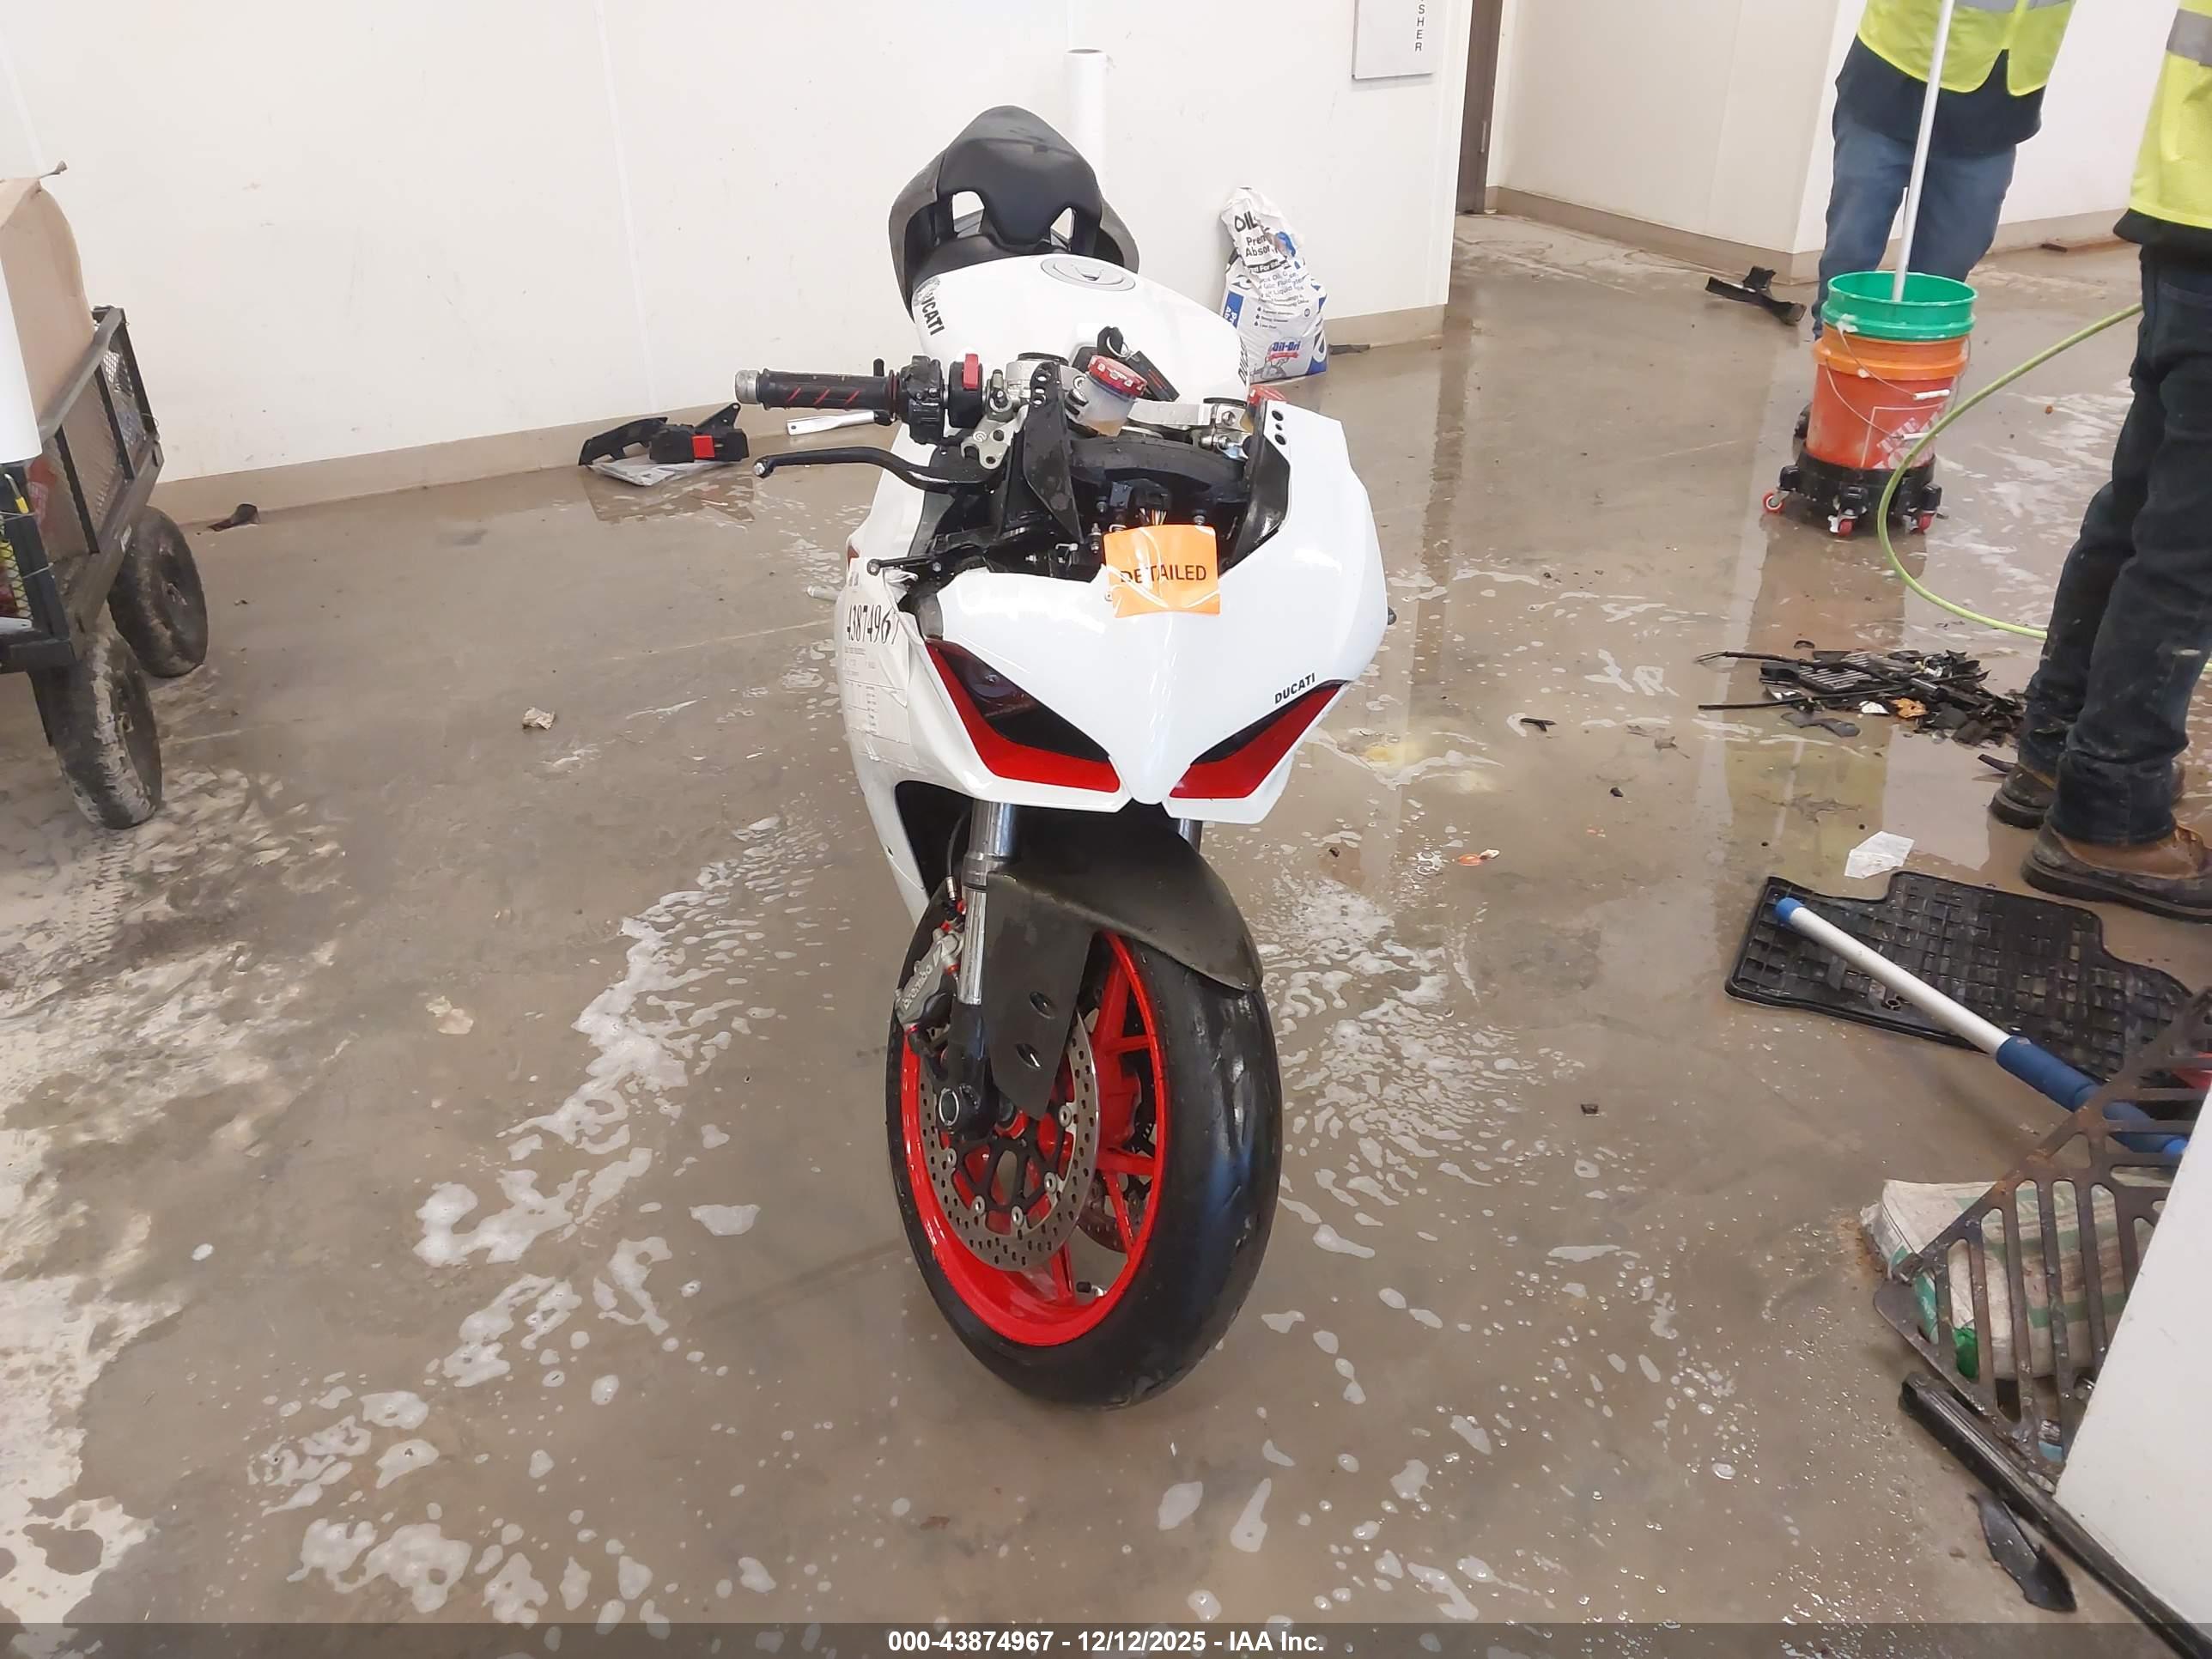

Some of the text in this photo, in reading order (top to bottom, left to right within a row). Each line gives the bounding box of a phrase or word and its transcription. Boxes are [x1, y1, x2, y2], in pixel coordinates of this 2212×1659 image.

[1415, 0, 1425, 52] SHER
[920, 290, 945, 336] UCATI
[1120, 564, 1207, 584] DETAILED
[1274, 672, 1316, 704] DUCATI
